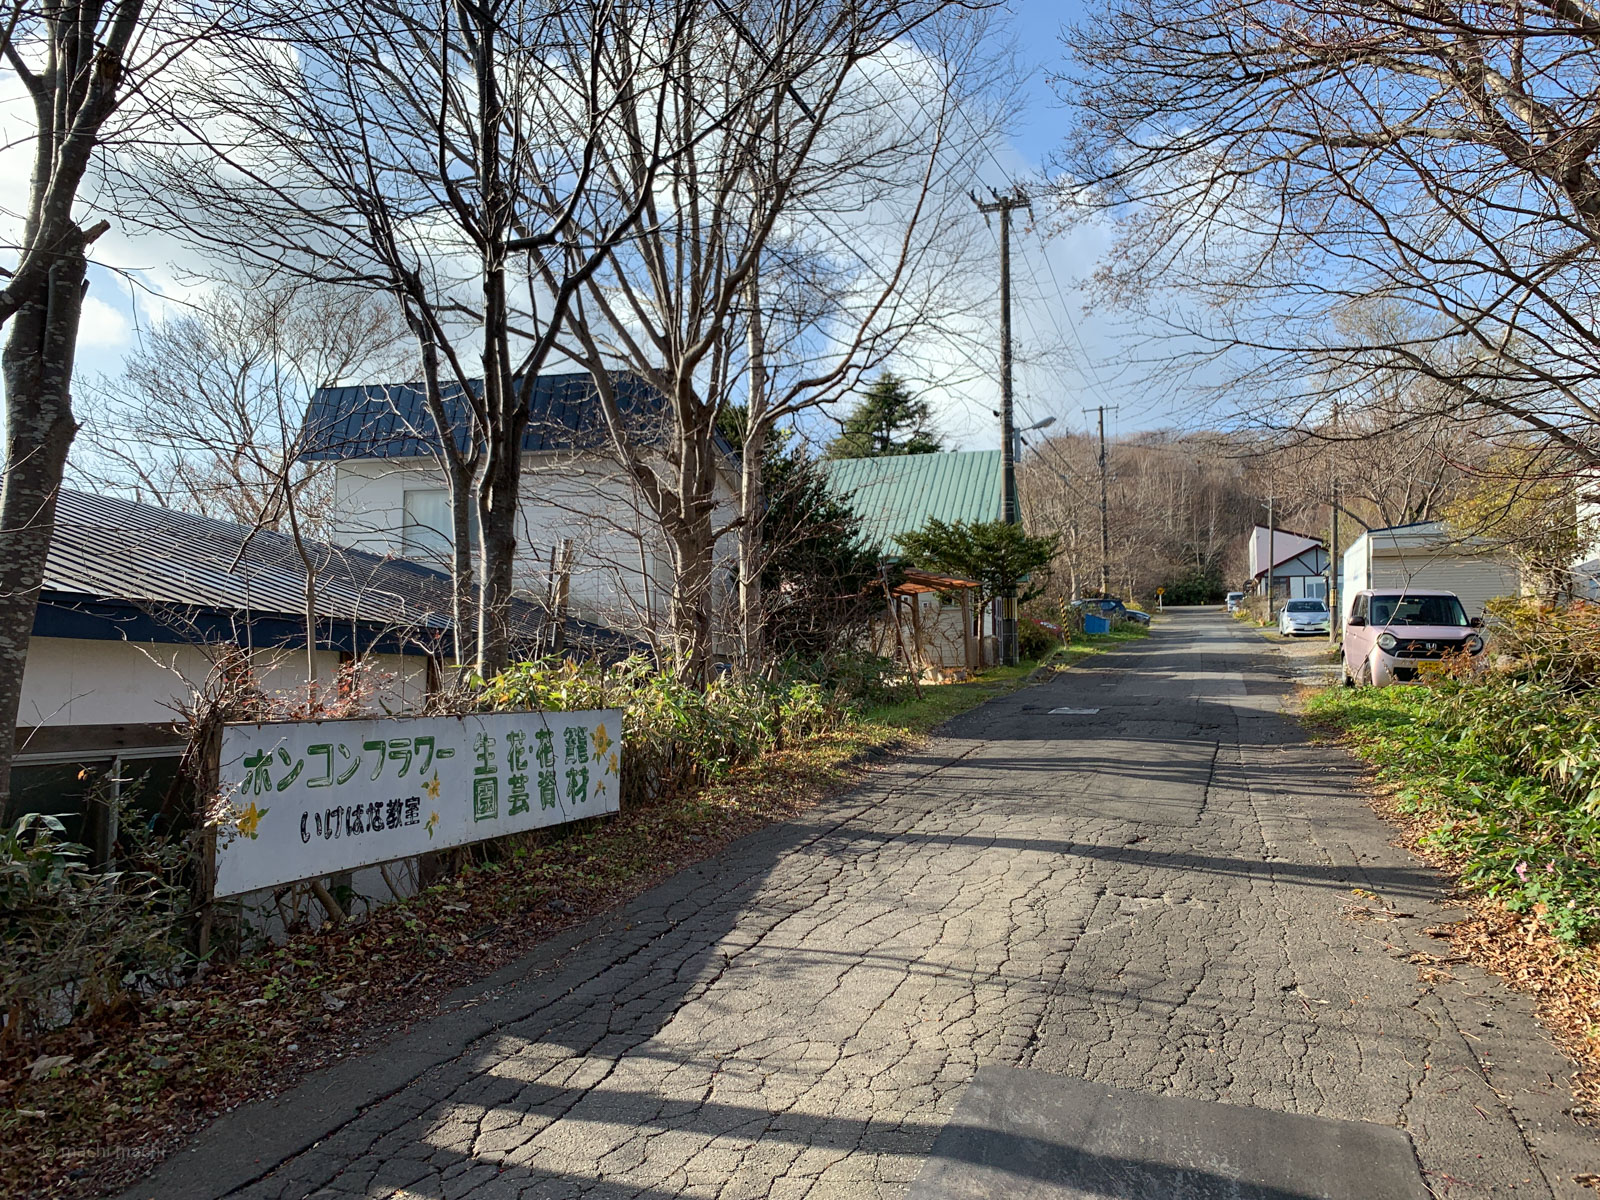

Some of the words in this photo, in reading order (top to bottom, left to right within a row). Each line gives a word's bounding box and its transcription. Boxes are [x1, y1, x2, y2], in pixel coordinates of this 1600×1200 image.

[241, 736, 455, 795] ホンコンフラワー
